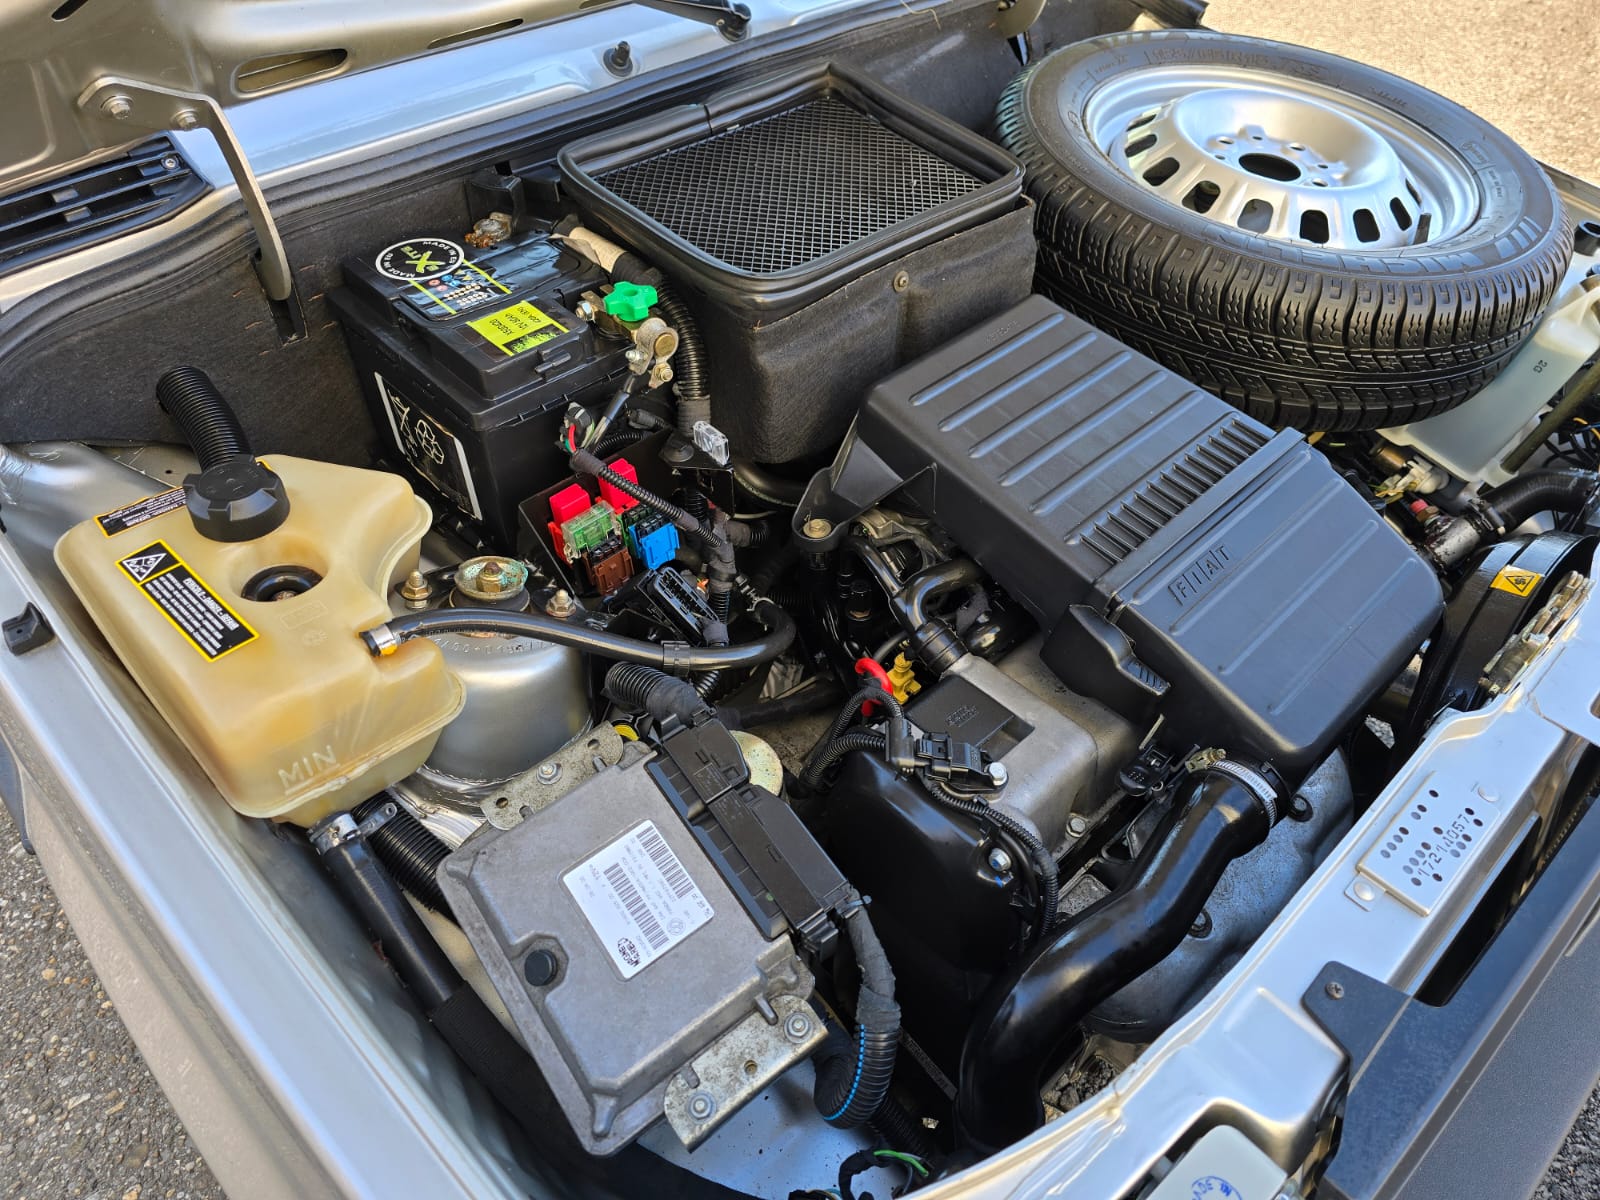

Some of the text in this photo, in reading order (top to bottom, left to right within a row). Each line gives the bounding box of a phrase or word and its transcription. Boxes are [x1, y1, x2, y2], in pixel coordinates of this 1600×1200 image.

[423, 241, 450, 250] MADE
[388, 268, 415, 278] MADE
[1175, 545, 1229, 599] FIAT
[278, 744, 337, 789] MIN
[1192, 1178, 1214, 1200] ADE
